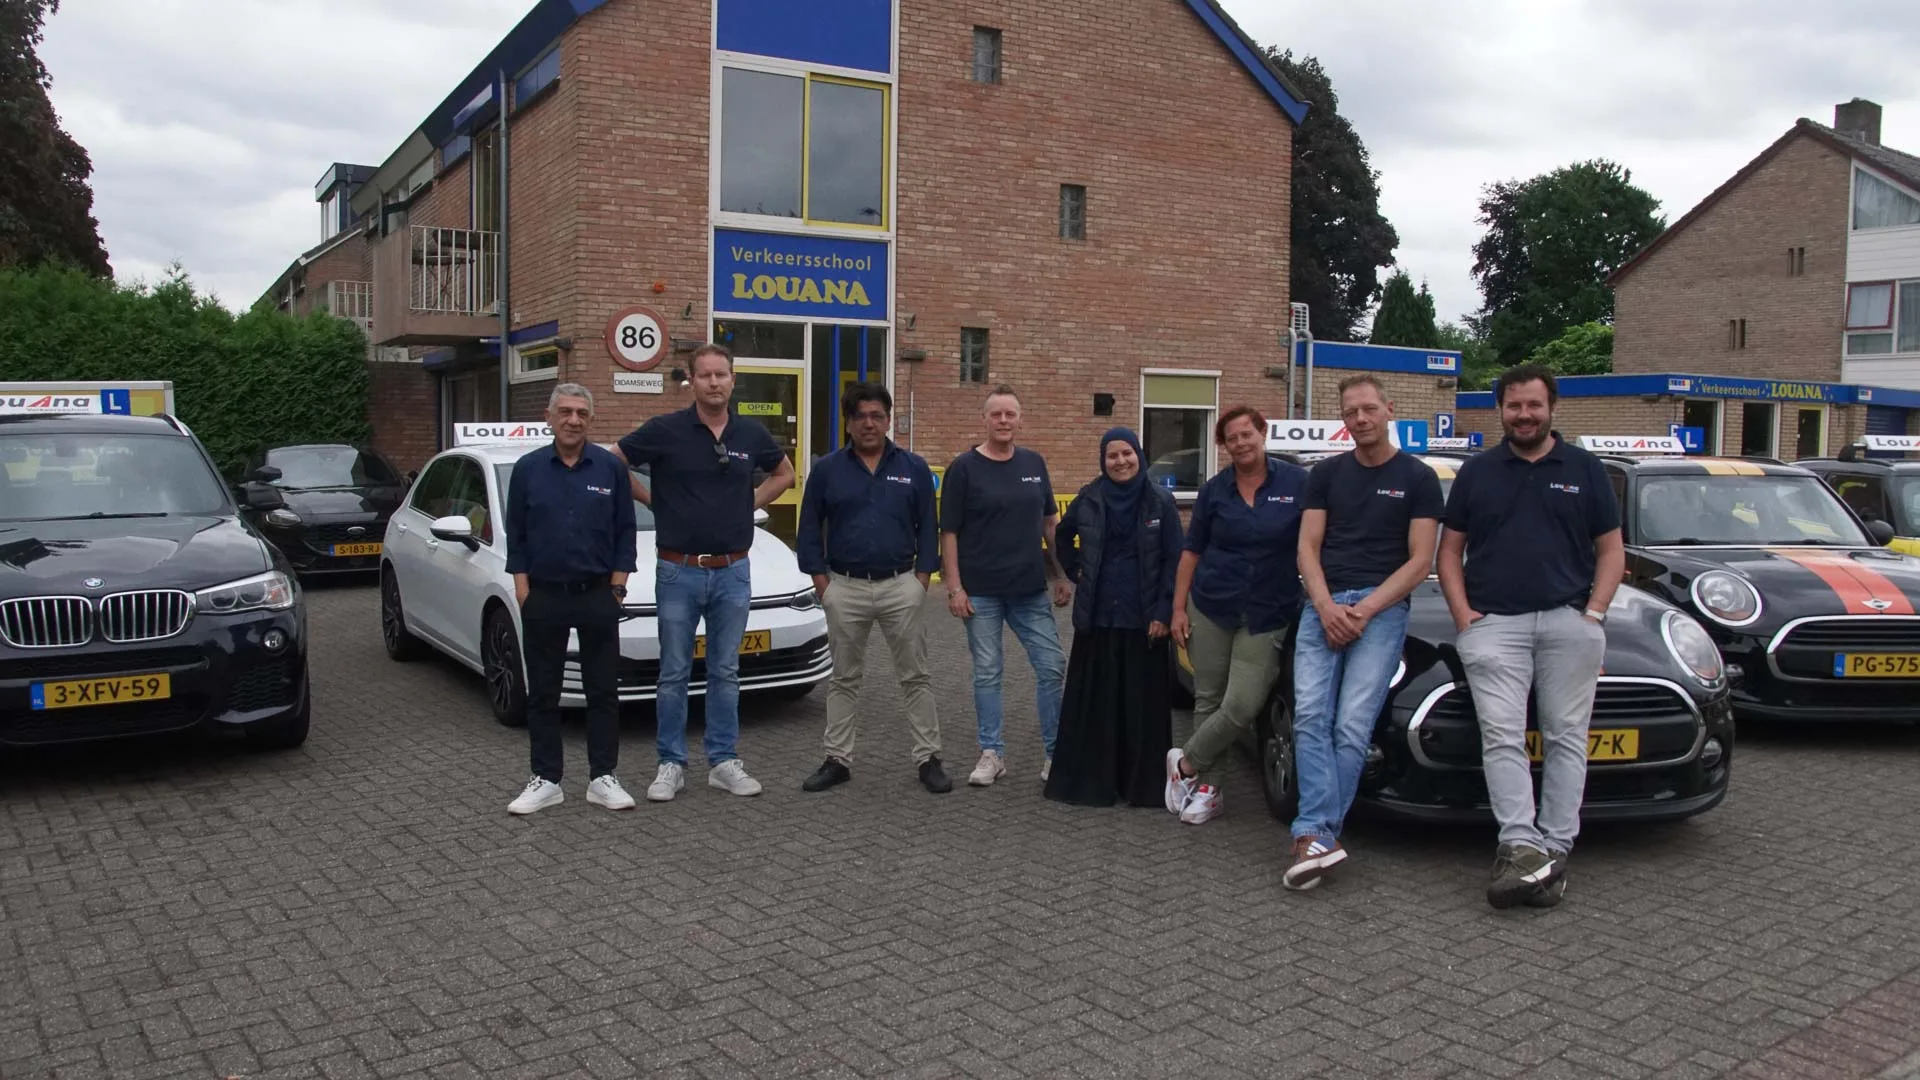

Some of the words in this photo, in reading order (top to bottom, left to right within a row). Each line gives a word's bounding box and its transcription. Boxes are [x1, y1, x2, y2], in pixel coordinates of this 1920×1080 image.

[731, 246, 872, 271] Verkeersschool
[732, 273, 872, 306] LOUANA
[621, 325, 656, 349] 86
[614, 379, 664, 387] DIDAMSEWEG
[1771, 383, 1823, 399] LOUANA
[108, 392, 122, 410] L
[1407, 426, 1421, 447] L
[1438, 415, 1451, 437] P
[1470, 435, 1478, 446] L
[1685, 431, 1697, 448] L
[54, 677, 160, 704] 3-XFV-59
